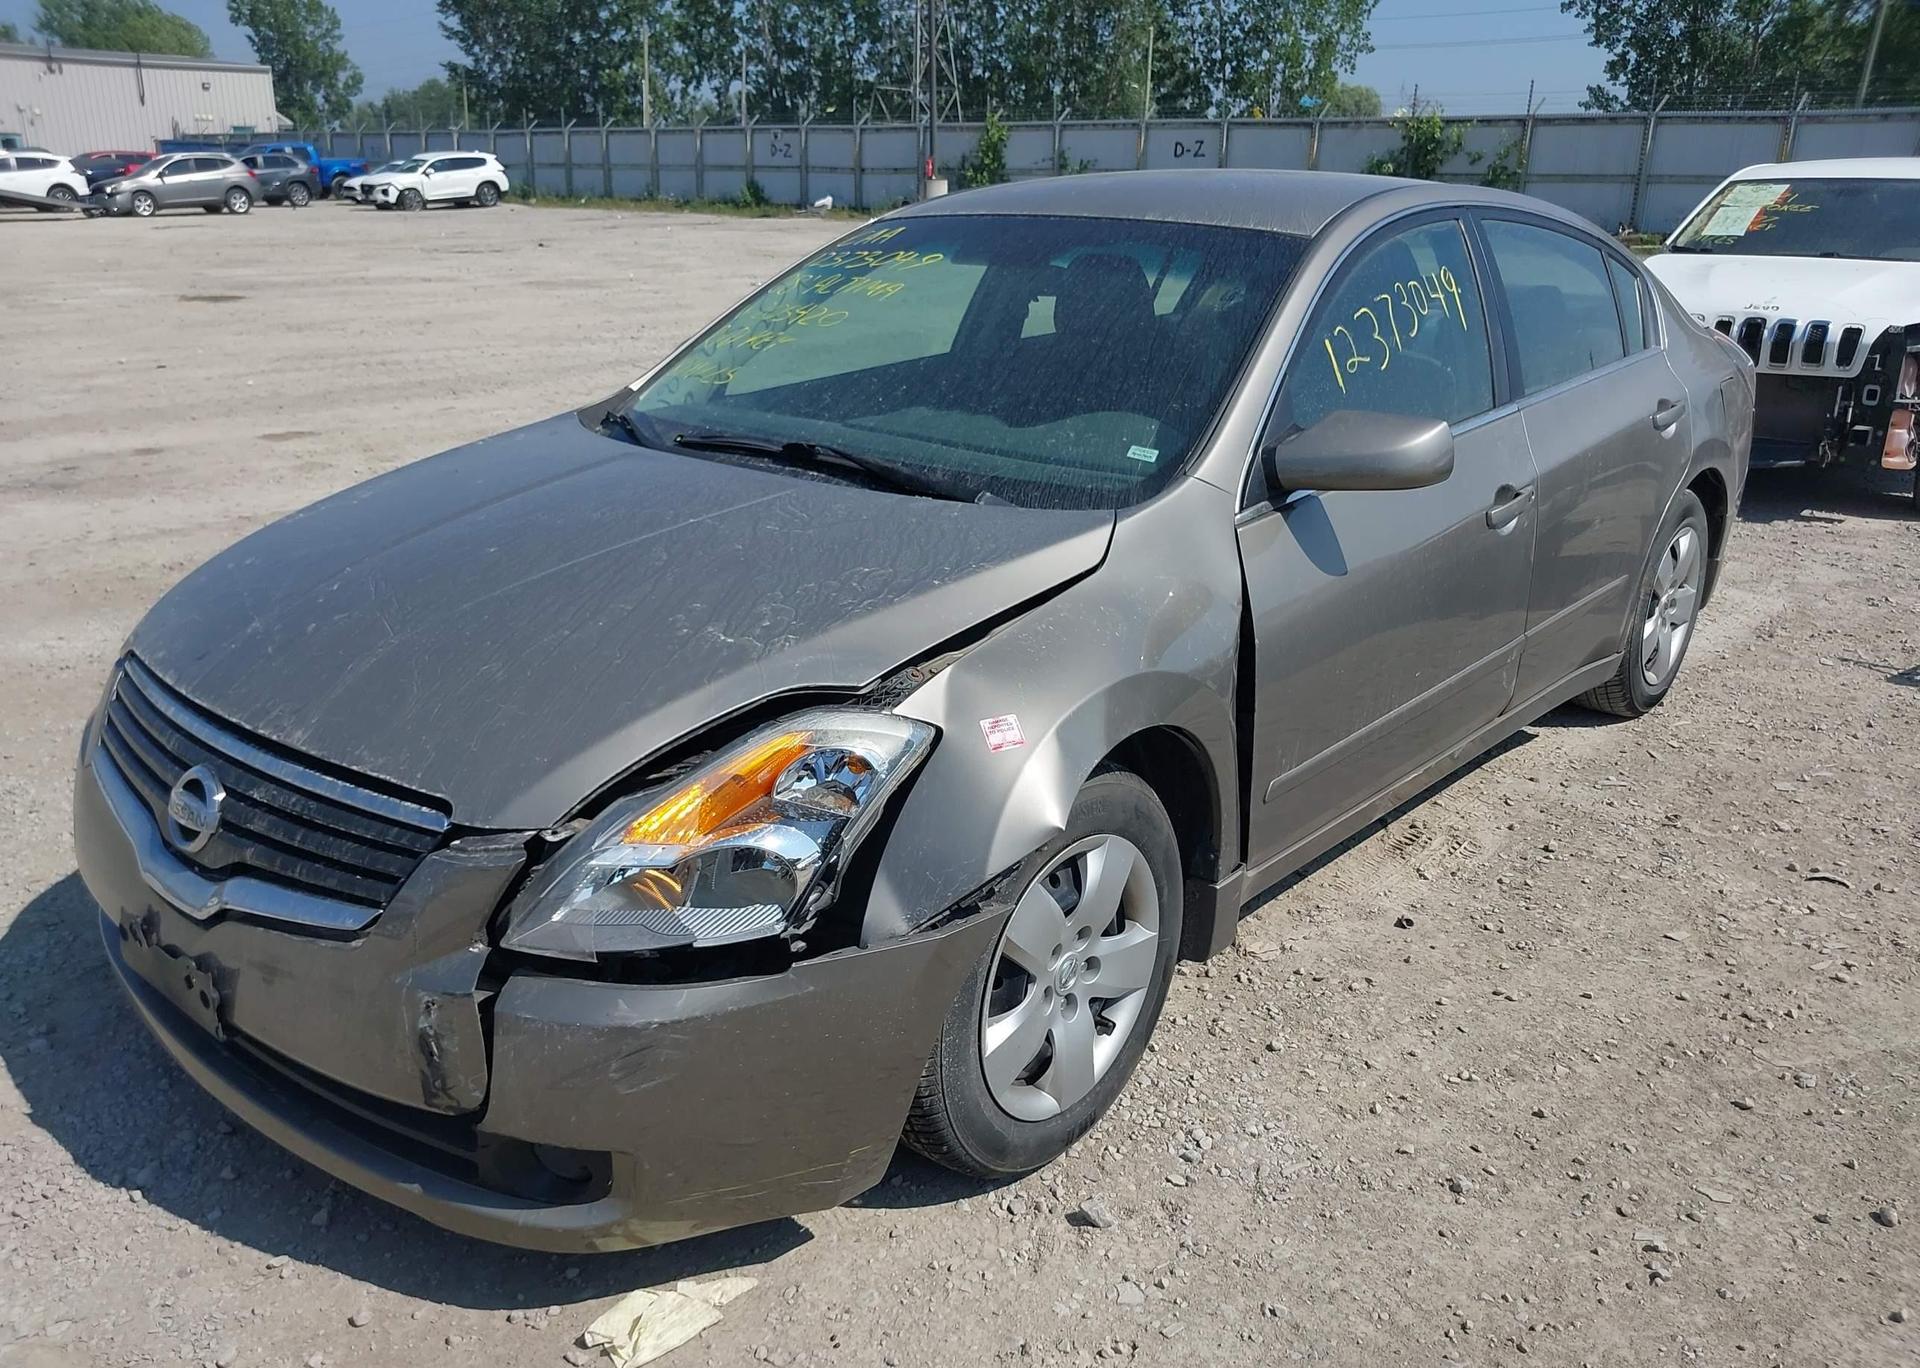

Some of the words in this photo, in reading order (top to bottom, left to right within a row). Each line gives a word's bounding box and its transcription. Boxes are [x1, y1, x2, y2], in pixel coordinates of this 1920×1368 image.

[770, 143, 793, 159] D-Z
[1173, 139, 1206, 158] D-Z
[1324, 265, 1468, 395] 12373049
